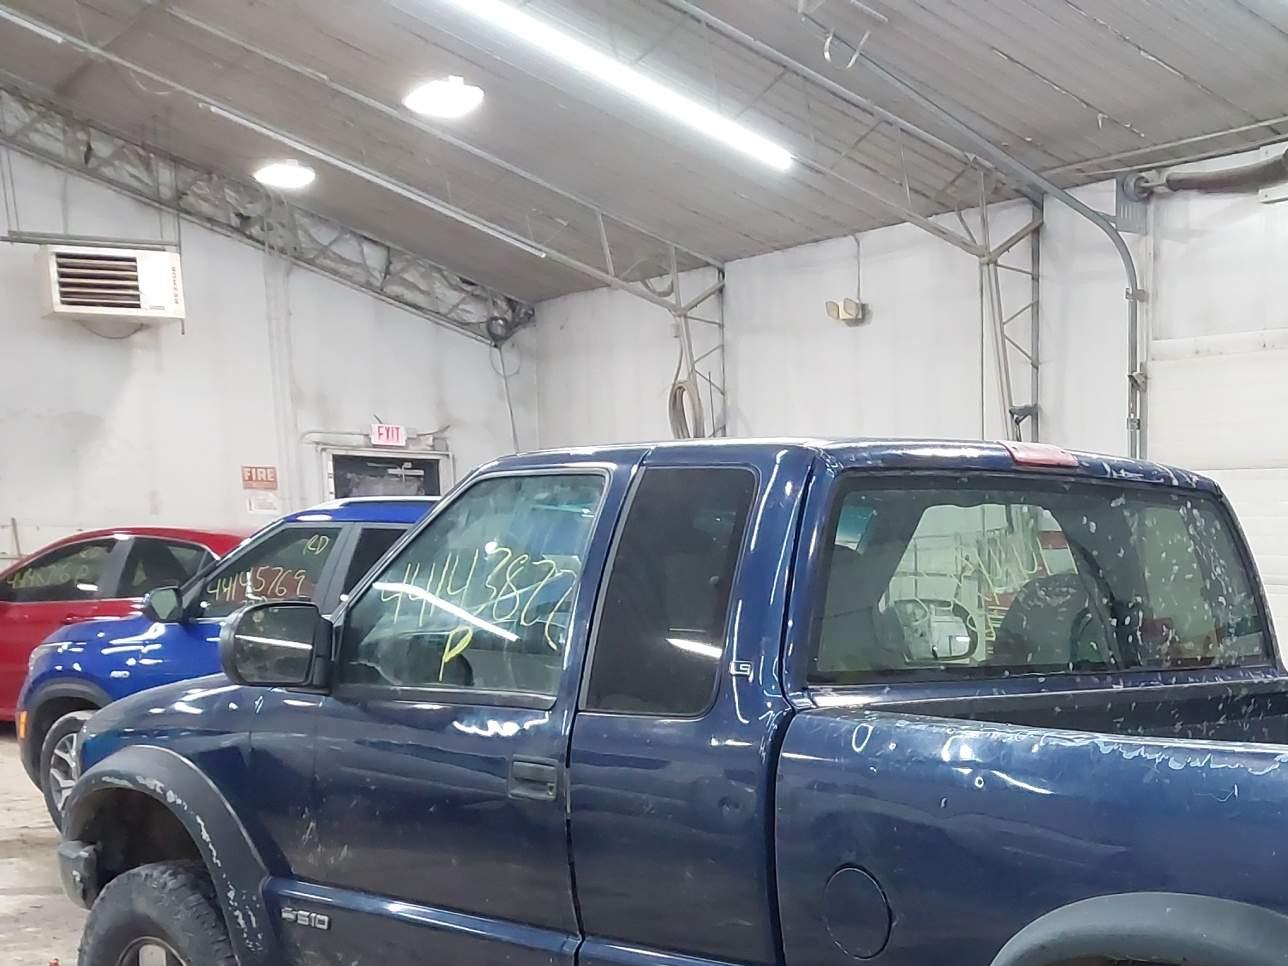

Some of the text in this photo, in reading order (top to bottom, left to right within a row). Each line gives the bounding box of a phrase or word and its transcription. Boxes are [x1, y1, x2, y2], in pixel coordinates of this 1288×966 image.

[377, 425, 402, 442] EXIT
[244, 468, 275, 481] FIRE
[297, 910, 331, 931] S10
